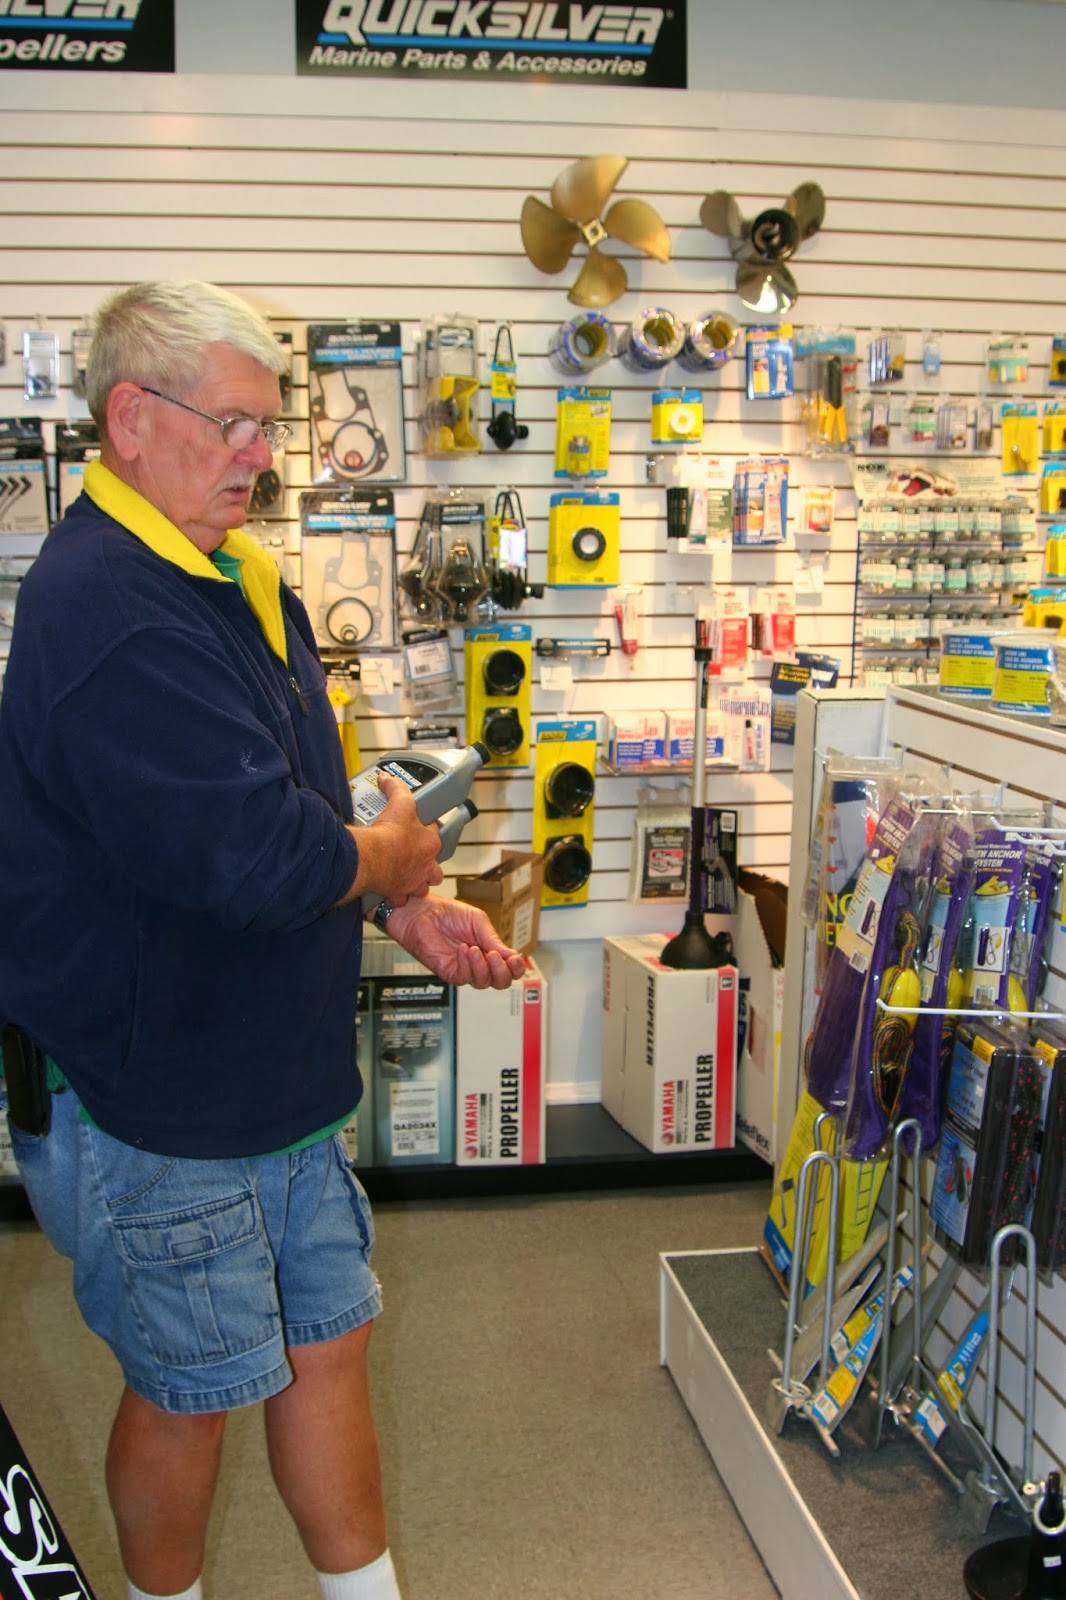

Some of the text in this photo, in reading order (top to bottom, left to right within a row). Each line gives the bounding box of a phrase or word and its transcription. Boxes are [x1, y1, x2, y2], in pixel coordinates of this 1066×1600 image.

[322, 0, 664, 45] QUICKSILVER
[309, 45, 647, 75] Marine Parts & Accessories
[988, 850, 1021, 859] ANCHOR
[382, 1013, 443, 1021] ALUMINUM
[646, 976, 655, 1067] PROPELLER
[465, 1093, 478, 1145] YAMAHA
[500, 1068, 519, 1158] PROPELLER
[662, 1080, 675, 1131] YAMAHA
[695, 1054, 713, 1143] PROPELLER
